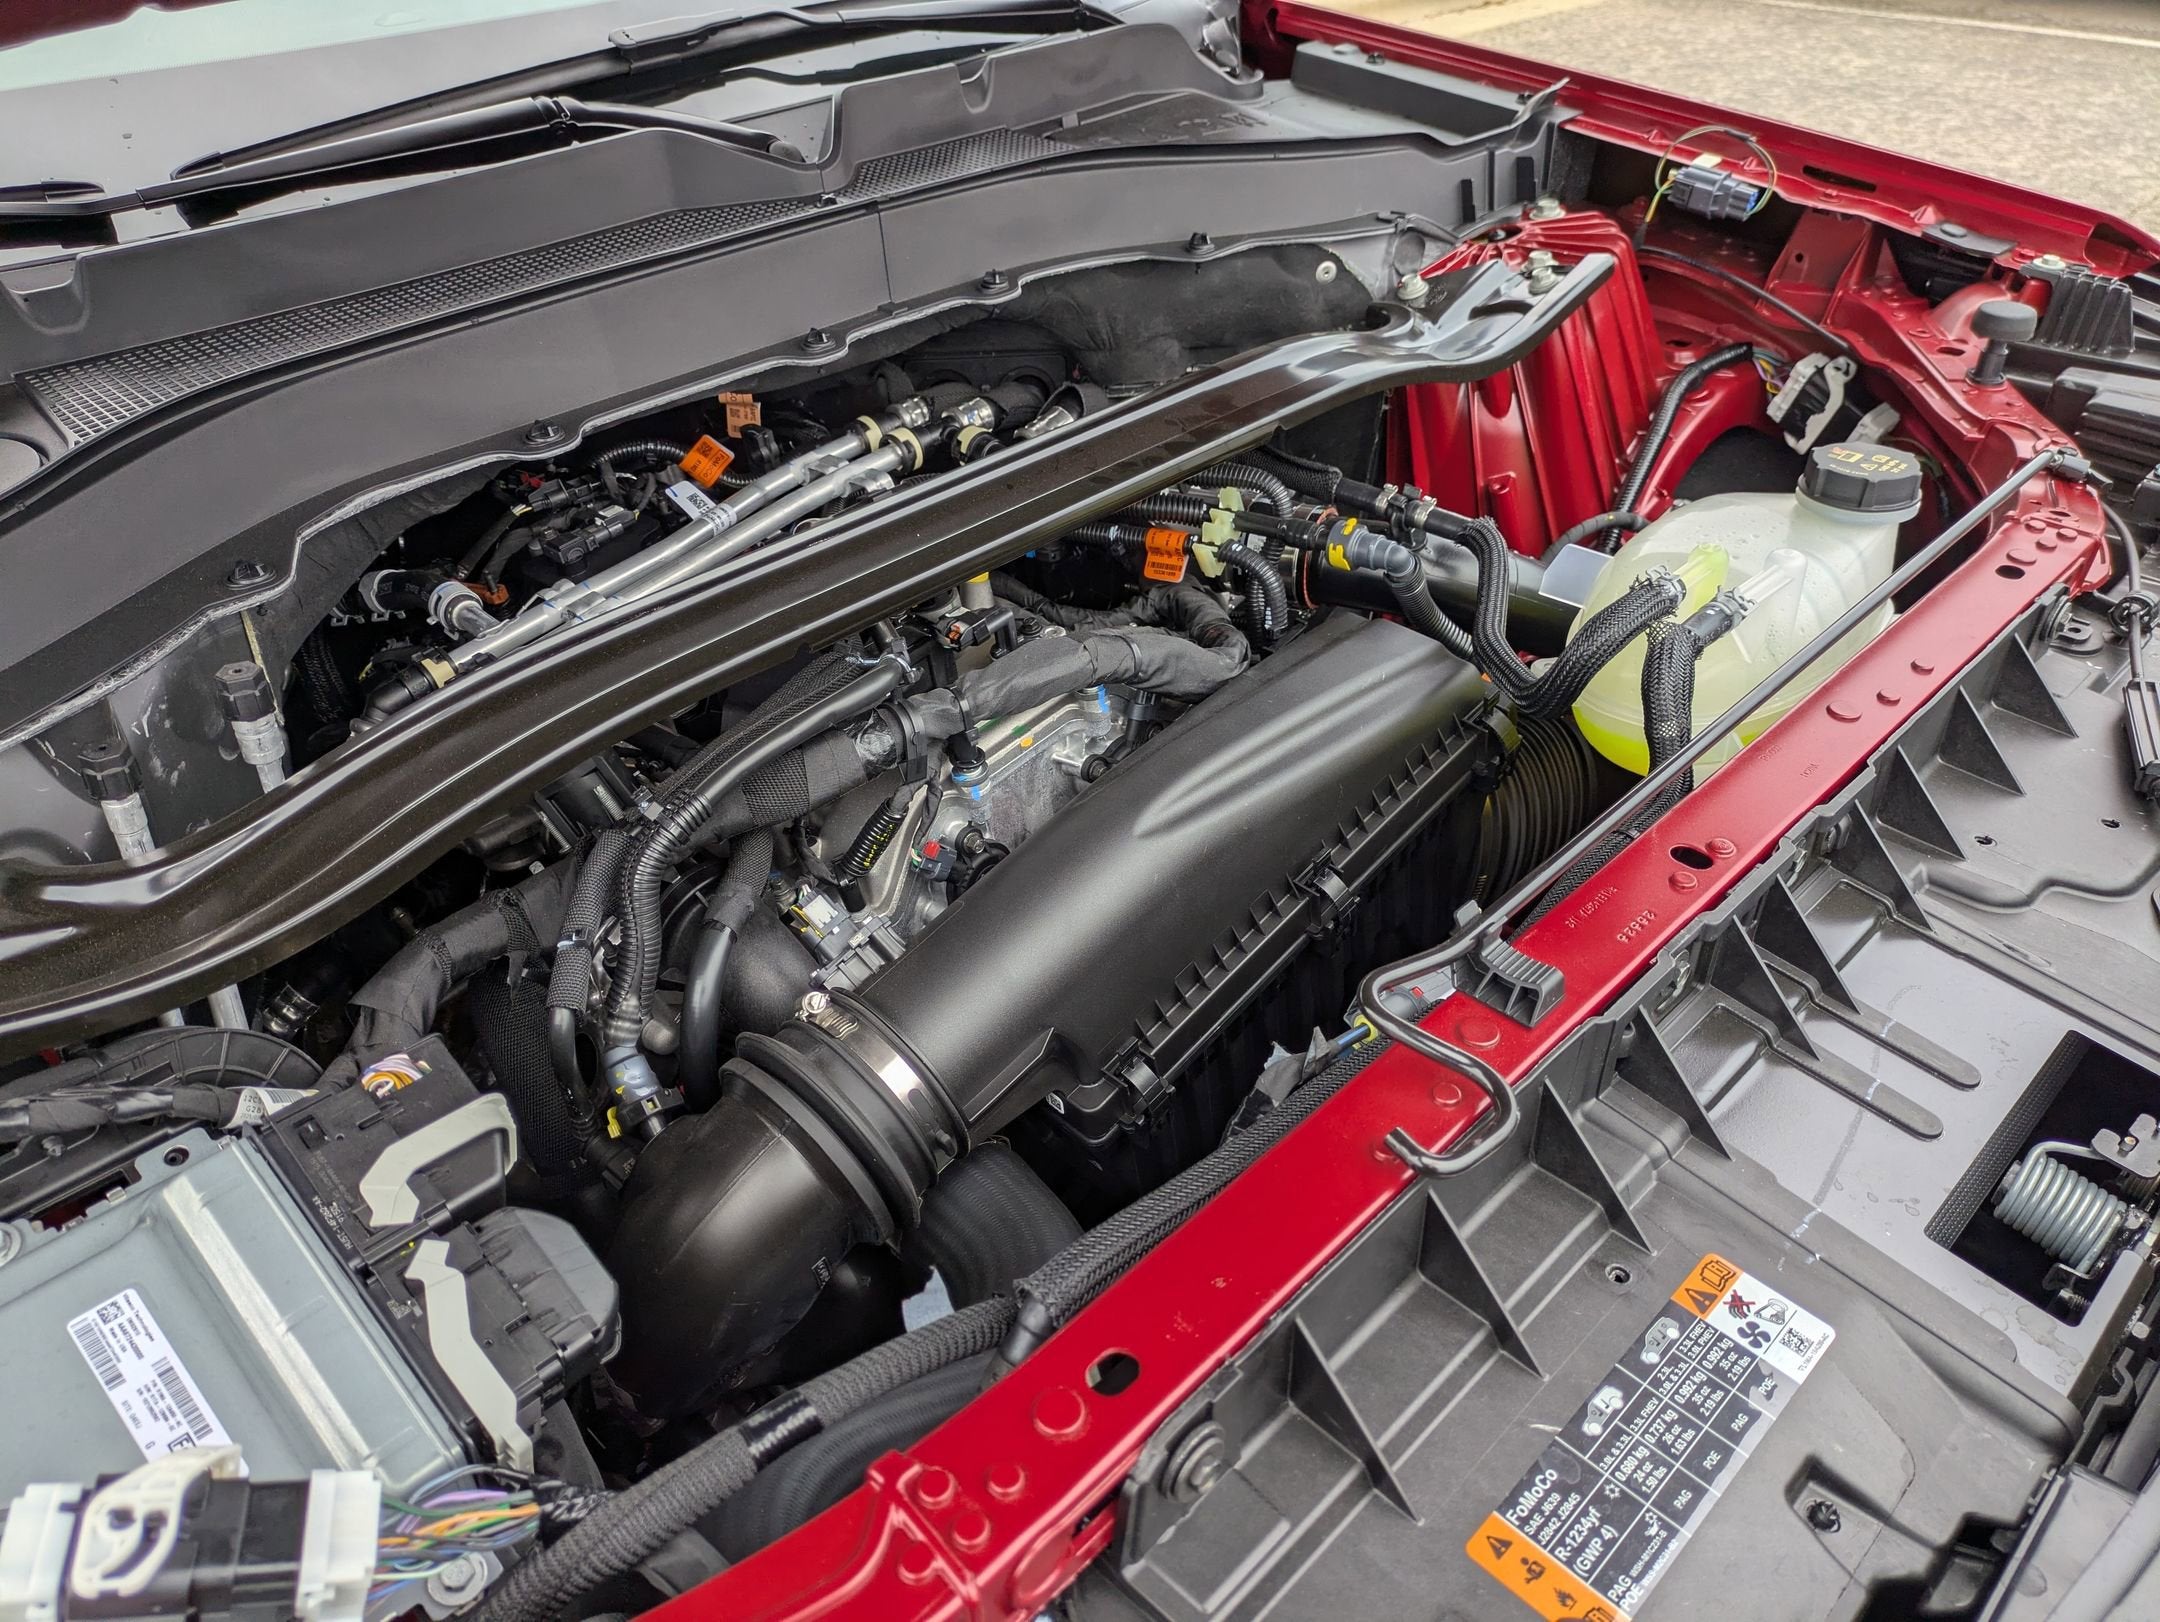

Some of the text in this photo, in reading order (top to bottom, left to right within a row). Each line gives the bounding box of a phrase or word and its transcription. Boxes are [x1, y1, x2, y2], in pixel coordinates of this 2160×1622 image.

[1679, 1320, 1706, 1352] 3.3L FHEV
[1687, 1326, 1714, 1358] 3.0L PHEV
[1702, 1337, 1734, 1369] 0.992 kg
[1719, 1351, 1738, 1370] 35 oz
[1727, 1355, 1751, 1381] 2.19 lbs
[1658, 1361, 1689, 1395] 3.0L & 3.3L
[1674, 1370, 1707, 1403] 0.992 kg
[1756, 1376, 1776, 1395] POE
[1691, 1385, 1711, 1404] 35 oz
[1699, 1389, 1724, 1416] 2.19 lbs
[1629, 1396, 1658, 1431] 3.3L FHEV
[1644, 1408, 1678, 1443] 0.737 kg
[1730, 1413, 1748, 1431] PAG
[1662, 1424, 1682, 1444] 26 oz
[1670, 1428, 1695, 1455] 1.63 lbs
[1599, 1433, 1632, 1470] 3.0L & 3.3L
[1614, 1445, 1650, 1481] 0.680 kg
[1702, 1450, 1721, 1469] POE
[1632, 1461, 1653, 1482] 24 oz
[1641, 1465, 1667, 1493] 1.50 lbs
[1505, 1468, 1558, 1525] FoMoCo
[1673, 1489, 1692, 1509] PAG
[1523, 1492, 1561, 1535] SAE J639
[1538, 1492, 1580, 1545] J2842 J2845
[1554, 1505, 1601, 1561] R-1234yf
[1572, 1524, 1618, 1576] (GWP 4)
[1607, 1574, 1632, 1601] PAG
[1619, 1583, 1645, 1611] POE
